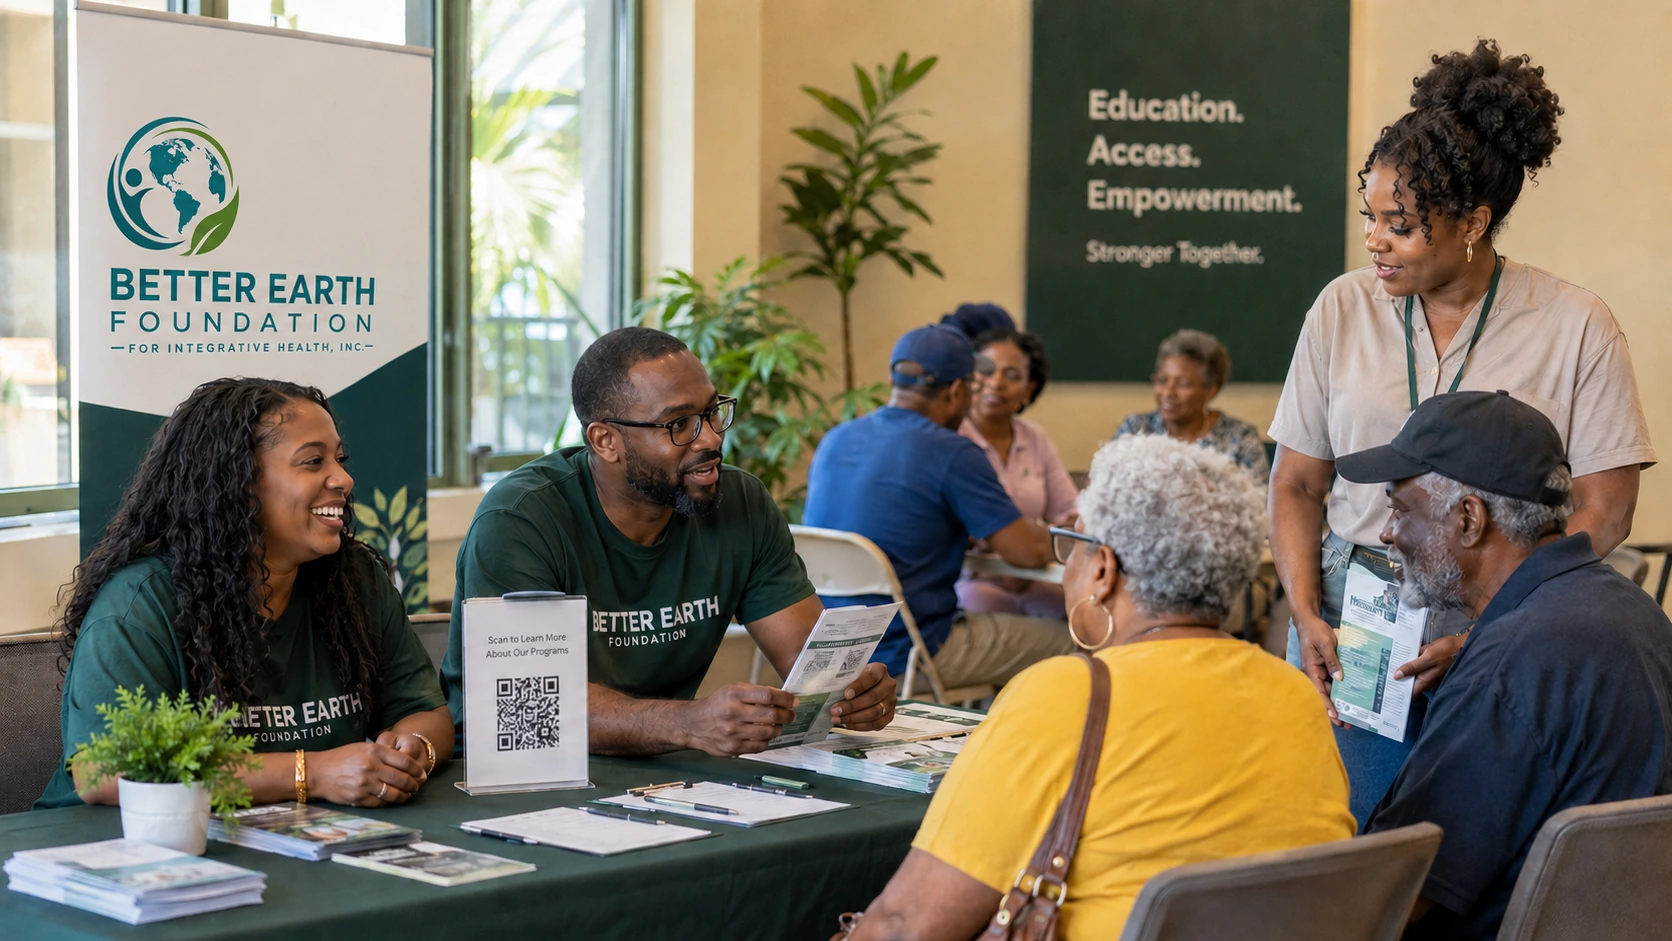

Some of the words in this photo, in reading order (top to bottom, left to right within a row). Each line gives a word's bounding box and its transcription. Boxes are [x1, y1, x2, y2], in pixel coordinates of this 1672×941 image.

[1088, 88, 1245, 124] Education.
[1086, 134, 1202, 168] Access.
[1087, 179, 1303, 219] Empowerment.
[1086, 239, 1173, 269] Stronger
[1176, 240, 1265, 269] Together.
[110, 267, 256, 303] BETTER
[269, 273, 375, 306] EARTH
[110, 310, 371, 333] FOUNDATION
[129, 343, 160, 354] FOR
[168, 343, 270, 354] INTEGRATIVE
[278, 342, 334, 354] HEALTH,
[340, 342, 365, 352] INC.
[592, 609, 655, 633] BETTER
[660, 595, 720, 628] EARTH
[485, 650, 512, 659] About
[513, 648, 529, 657] Our
[530, 646, 569, 658] Programs
[488, 636, 509, 645] Scan
[510, 635, 519, 644] to
[520, 635, 544, 643] Learn
[545, 633, 567, 642] More
[608, 628, 687, 648] FOUNDATION
[301, 691, 363, 724] EARTH
